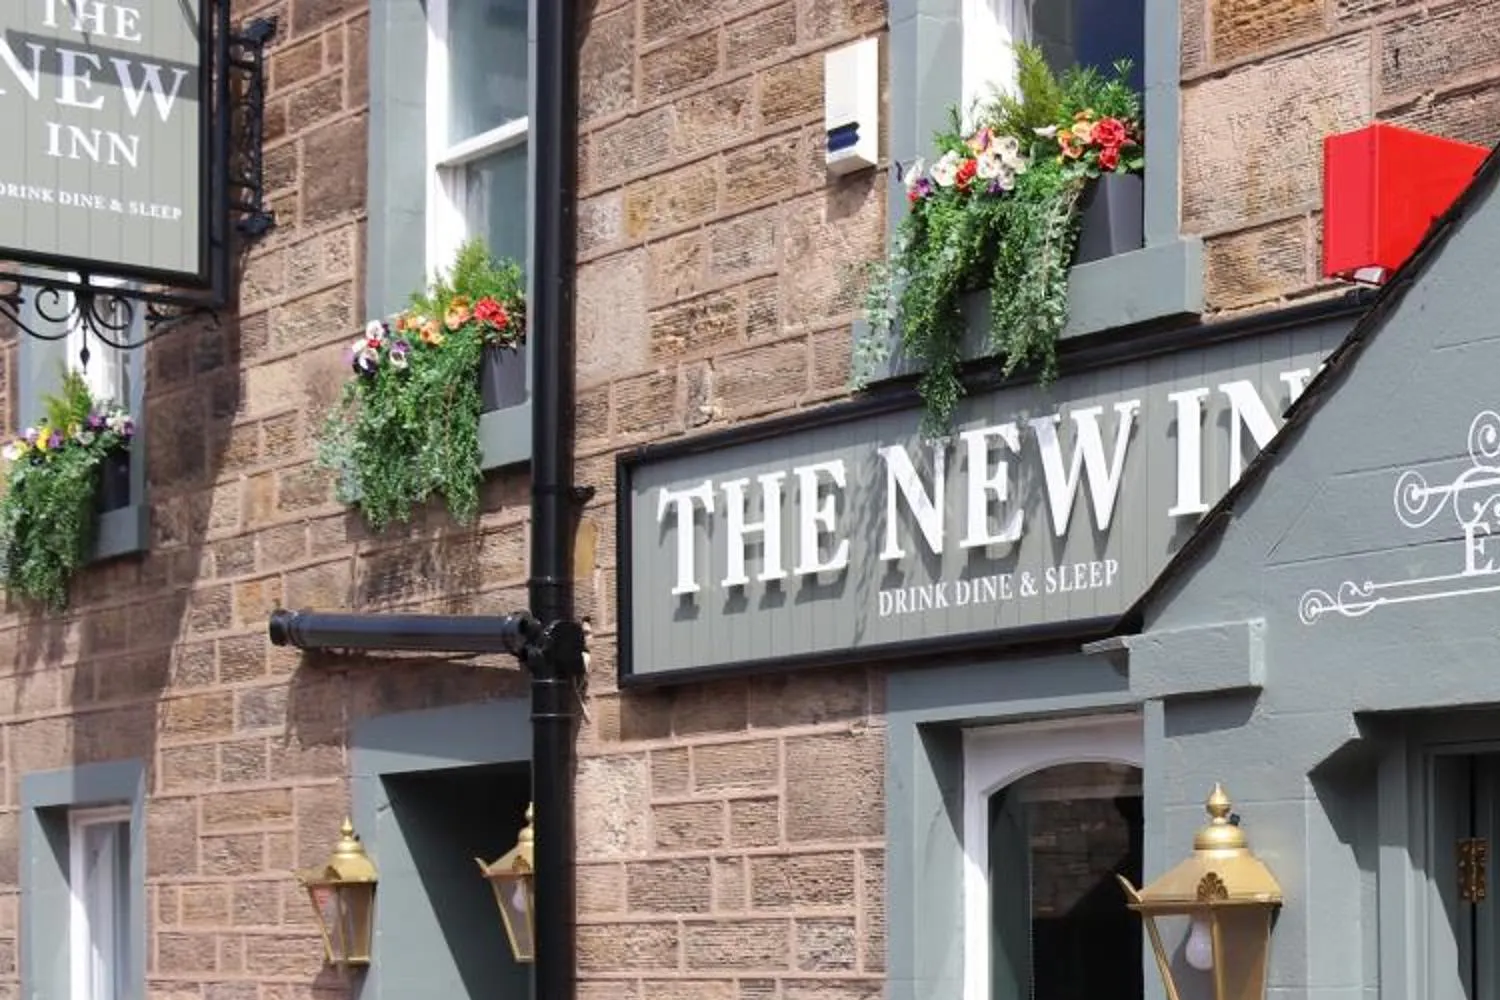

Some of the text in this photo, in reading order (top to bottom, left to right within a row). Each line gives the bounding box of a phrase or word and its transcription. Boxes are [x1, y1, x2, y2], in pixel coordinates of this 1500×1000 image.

[42, 0, 142, 42] THE
[0, 37, 188, 122] NEW
[46, 121, 139, 168] INN
[59, 190, 105, 210] DINE
[109, 199, 123, 213] &
[129, 201, 182, 220] SLEEP
[657, 364, 1327, 595] THE NEW IN
[878, 559, 1119, 616] DRINK DINE & SLEEP
